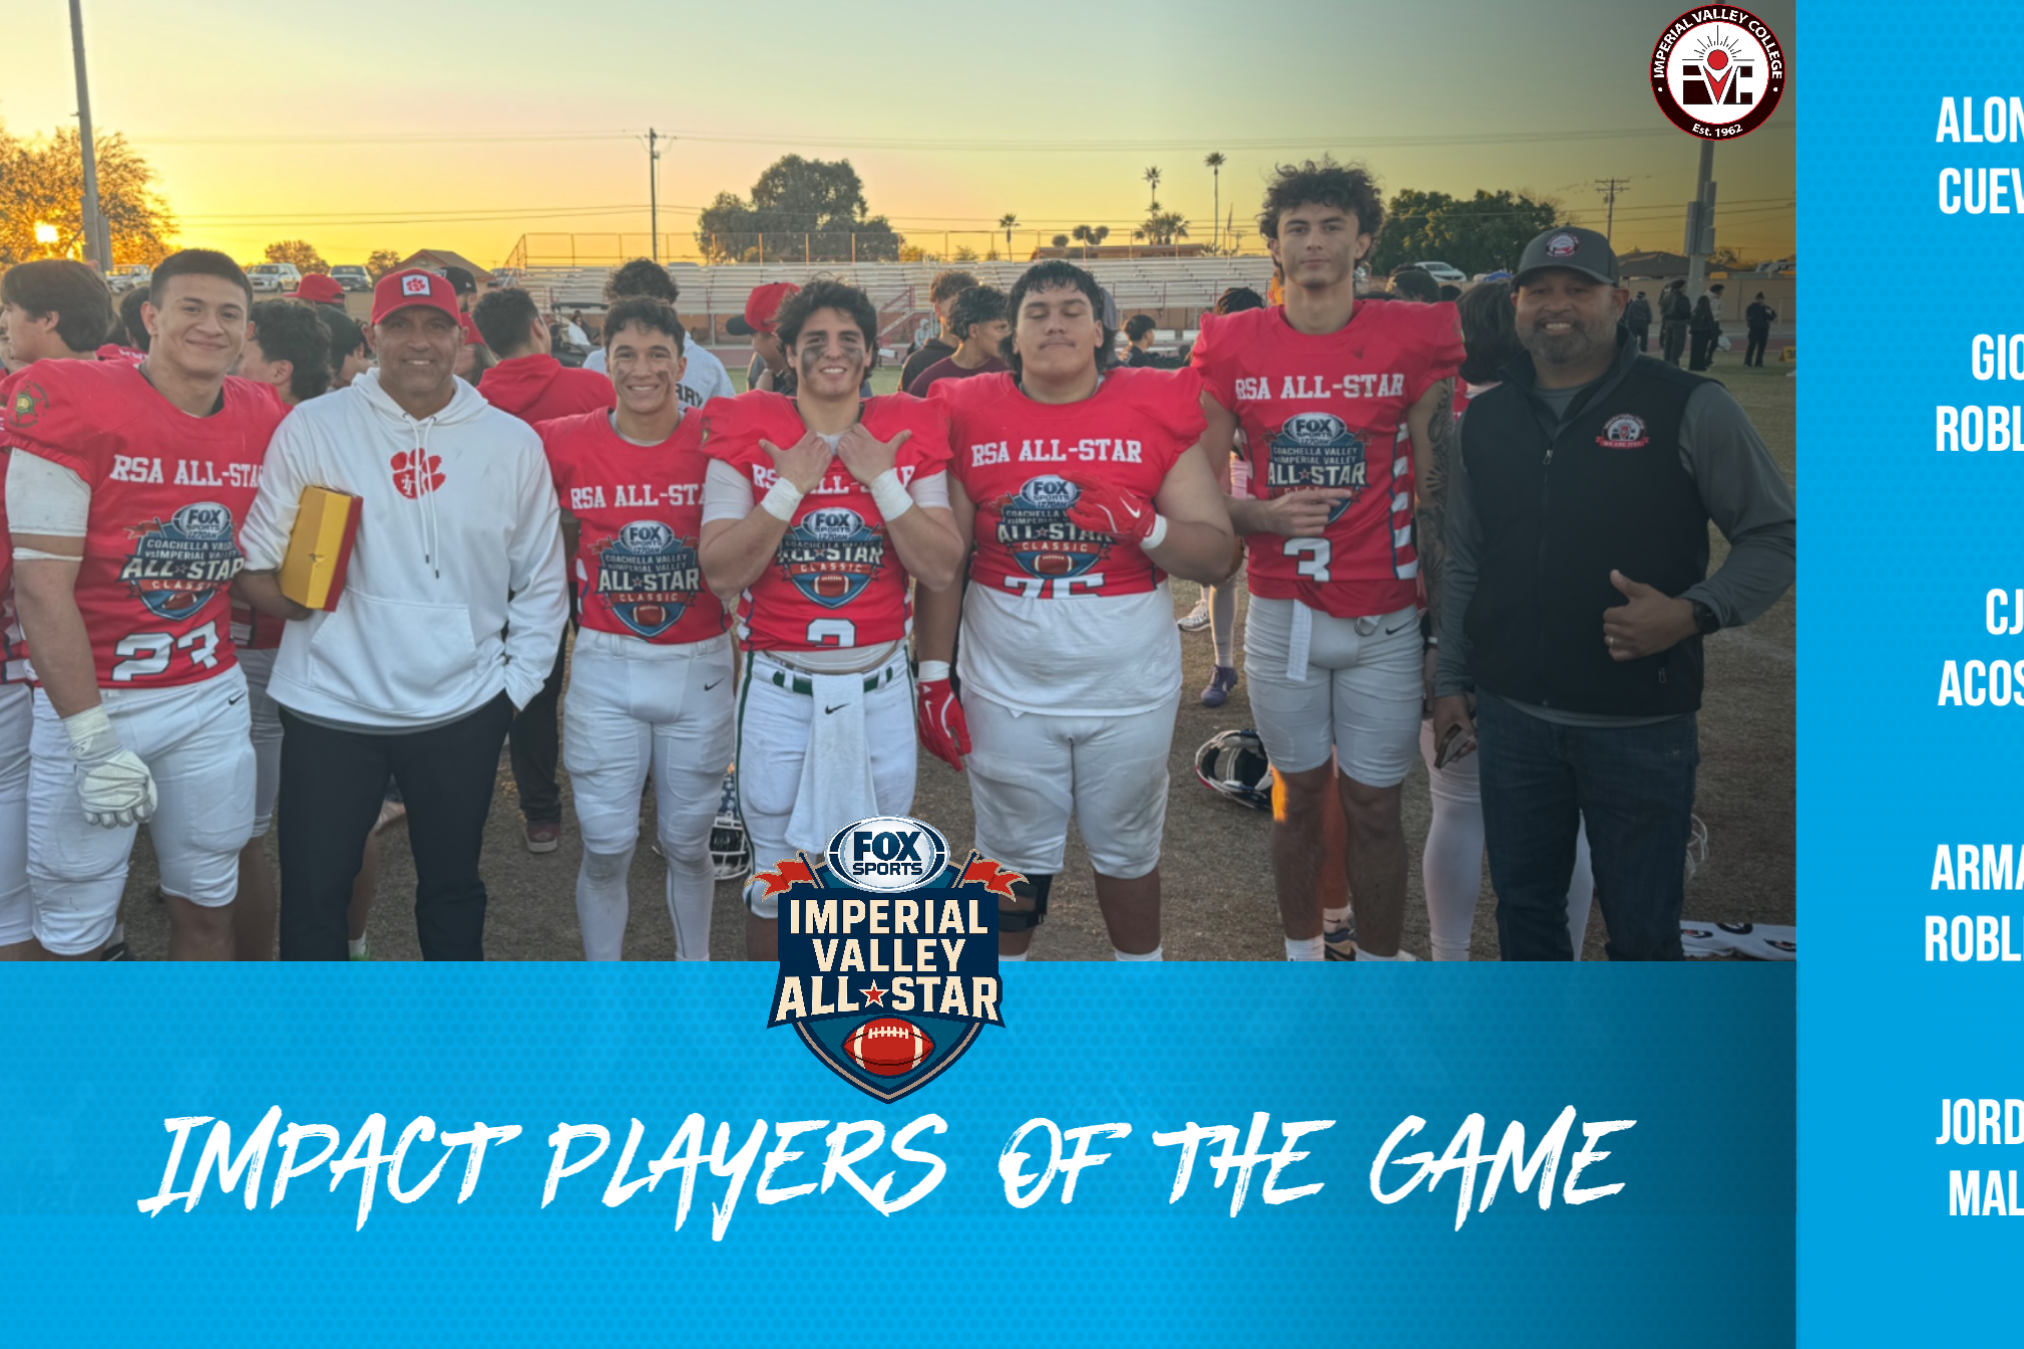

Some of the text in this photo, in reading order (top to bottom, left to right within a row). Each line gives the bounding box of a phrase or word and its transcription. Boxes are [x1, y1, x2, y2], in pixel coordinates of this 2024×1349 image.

[1235, 374, 1405, 400] RSA ALL-STAR
[1296, 419, 1333, 432] FOX
[971, 439, 1143, 467] RSA ALL-STAR
[1273, 447, 1358, 456] COACHELLA VALLEY
[1323, 457, 1356, 465] VALLEY
[109, 454, 264, 488] RSA ALL-STA
[752, 464, 778, 489] RS
[1268, 461, 1366, 486] ALL STAR
[1033, 481, 1069, 495] FOX
[570, 483, 706, 510] RSA ALL-STA
[187, 509, 222, 525] FOX
[815, 513, 850, 527] FOX
[1005, 510, 1060, 518] COACHELLA
[629, 526, 662, 541] FOX
[147, 539, 208, 551] COACHELLA
[1022, 542, 1088, 552] CLASSIC
[605, 553, 688, 564] COACHELLA VALLEY
[121, 558, 174, 579] ALL
[656, 562, 686, 573] VALLEY
[801, 564, 863, 573] CLASSIC
[598, 568, 700, 592] ALL STAR
[619, 593, 678, 602] CLASSIC
